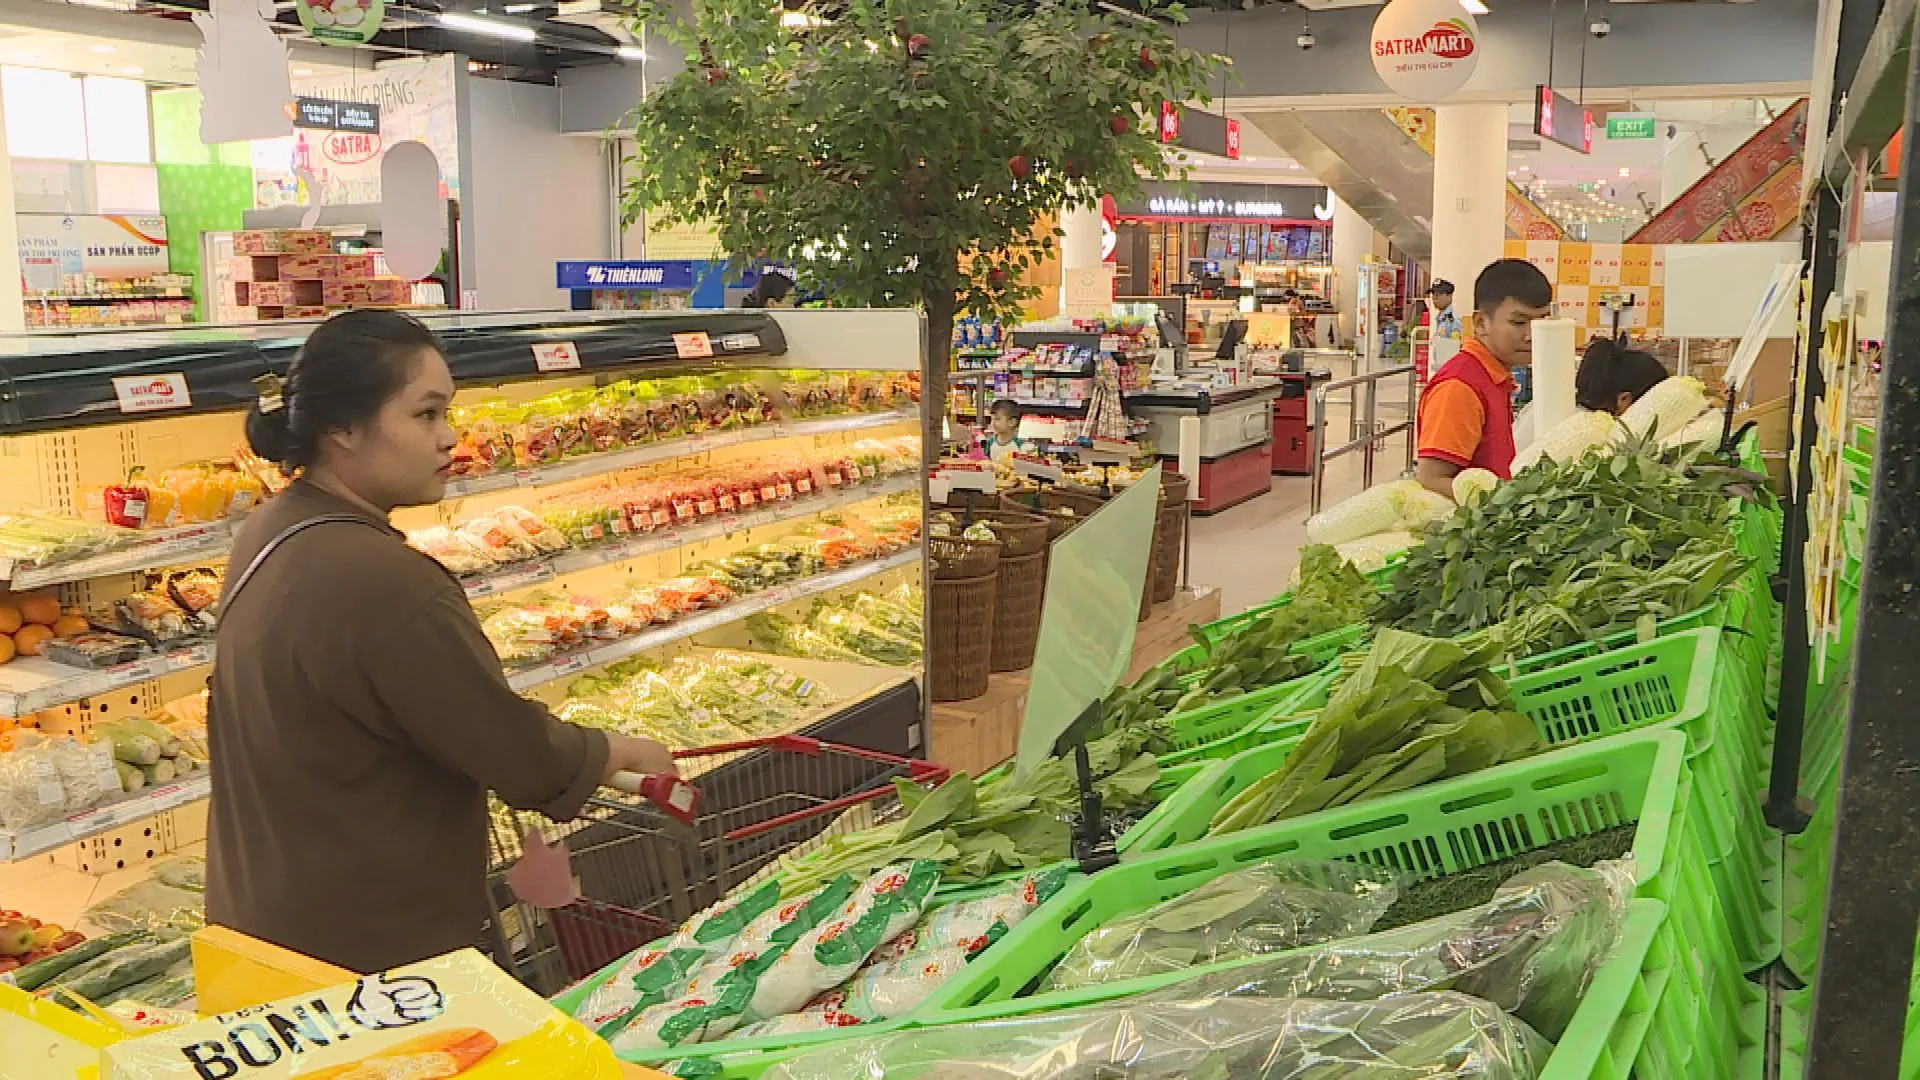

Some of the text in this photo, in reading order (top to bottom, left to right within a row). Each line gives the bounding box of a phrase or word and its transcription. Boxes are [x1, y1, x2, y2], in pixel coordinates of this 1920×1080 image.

[1375, 33, 1468, 57] SATRAMART
[1165, 112, 1175, 133] 06
[1616, 120, 1646, 131] EXIT
[331, 135, 372, 156] SATRA
[1228, 131, 1238, 149] 05
[87, 242, 161, 257] SẢN PHẨM OCOP
